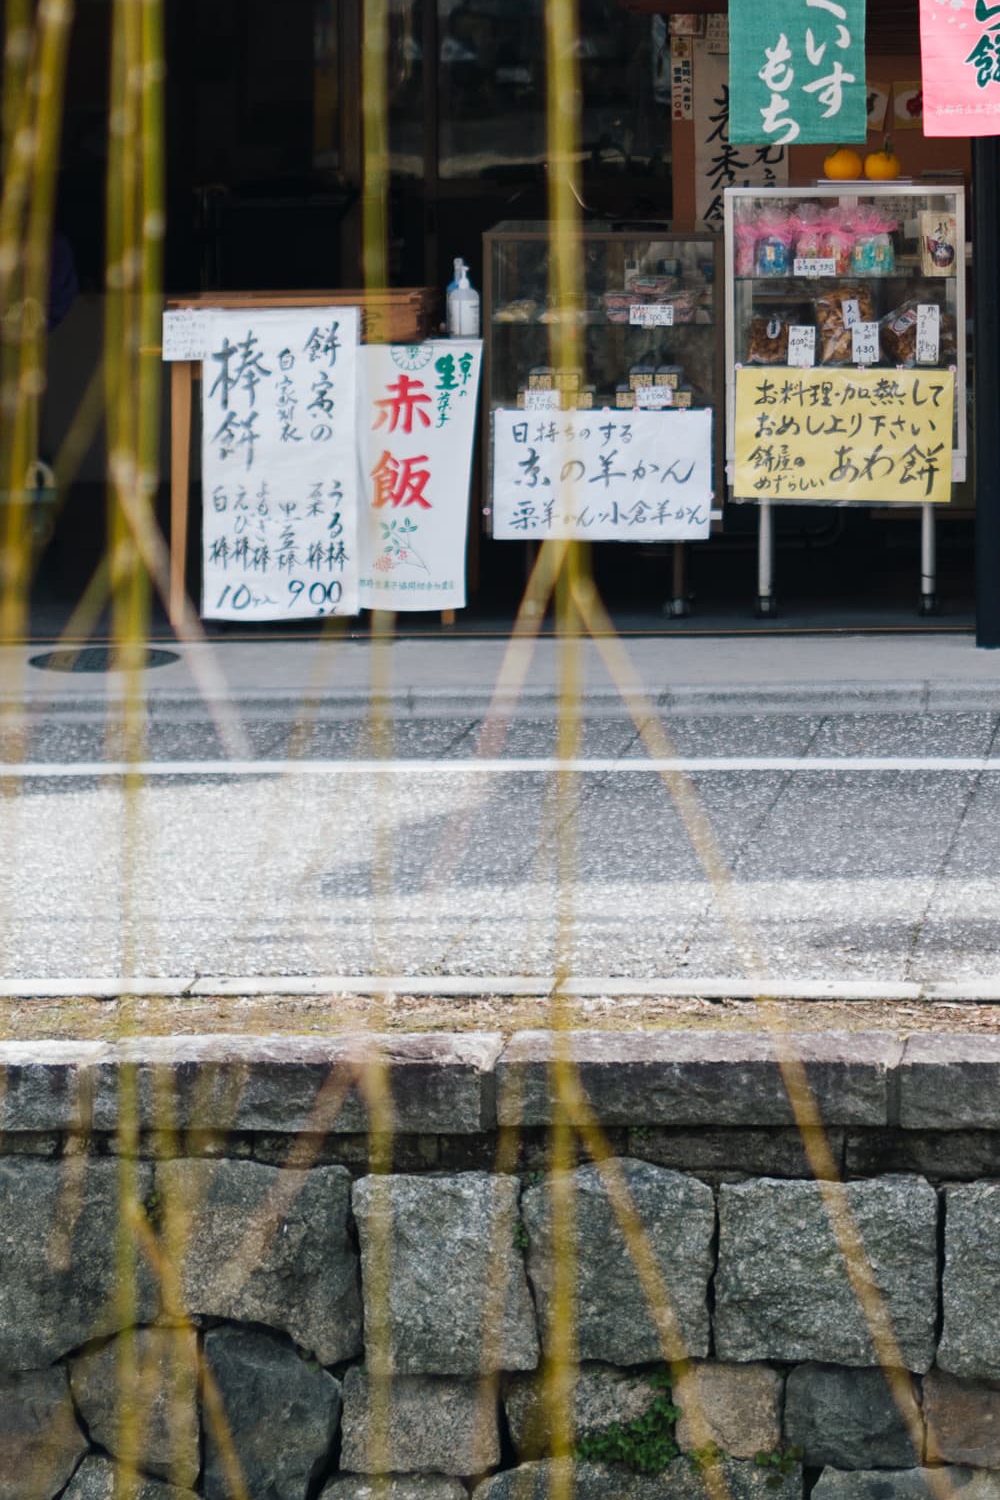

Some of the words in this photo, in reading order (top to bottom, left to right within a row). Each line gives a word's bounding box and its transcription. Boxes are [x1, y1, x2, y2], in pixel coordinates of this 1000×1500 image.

[758, 33, 801, 145] もち
[435, 353, 460, 428] 生菓子
[458, 352, 474, 396] 京の
[208, 330, 272, 472] 棒餅
[370, 374, 434, 511] 赤飯
[512, 421, 633, 447] 日持ちのする
[755, 412, 937, 440] おめし上り下さい
[514, 448, 696, 487] 京の羊かん
[747, 444, 806, 472] 餅屋の
[829, 442, 945, 497] あわ餅
[288, 580, 343, 609] 900
